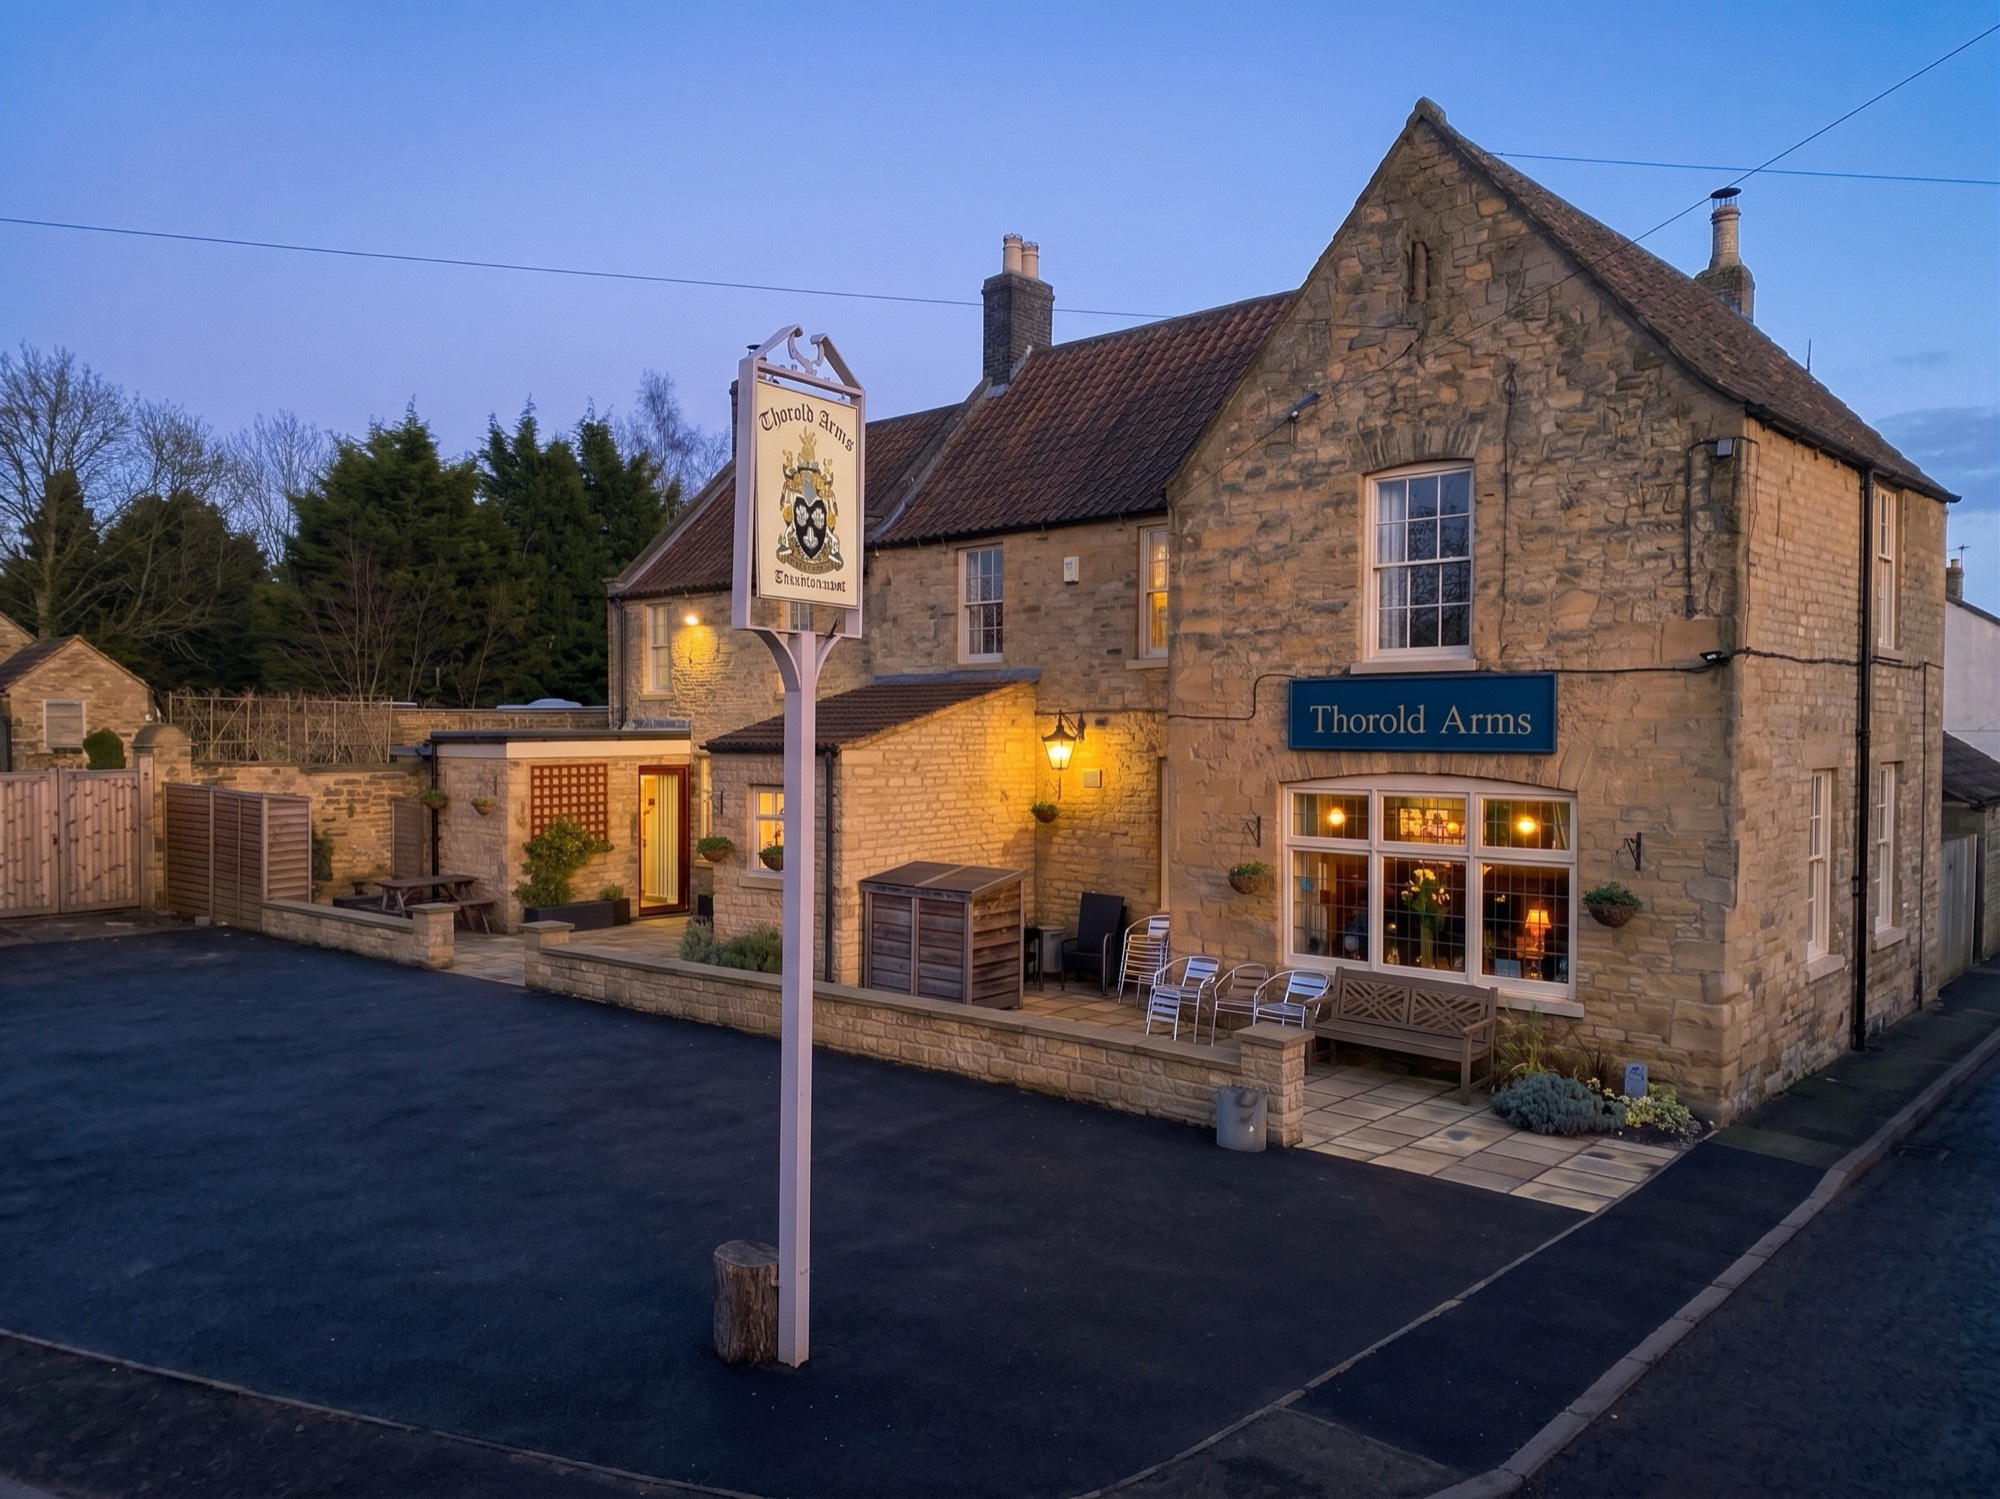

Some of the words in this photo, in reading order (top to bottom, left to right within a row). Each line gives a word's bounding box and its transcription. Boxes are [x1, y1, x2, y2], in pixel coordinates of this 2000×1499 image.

[759, 403, 814, 431] Thorold
[819, 410, 854, 452] Arms
[1309, 704, 1426, 734] Thorold
[1439, 704, 1532, 735] Arms
